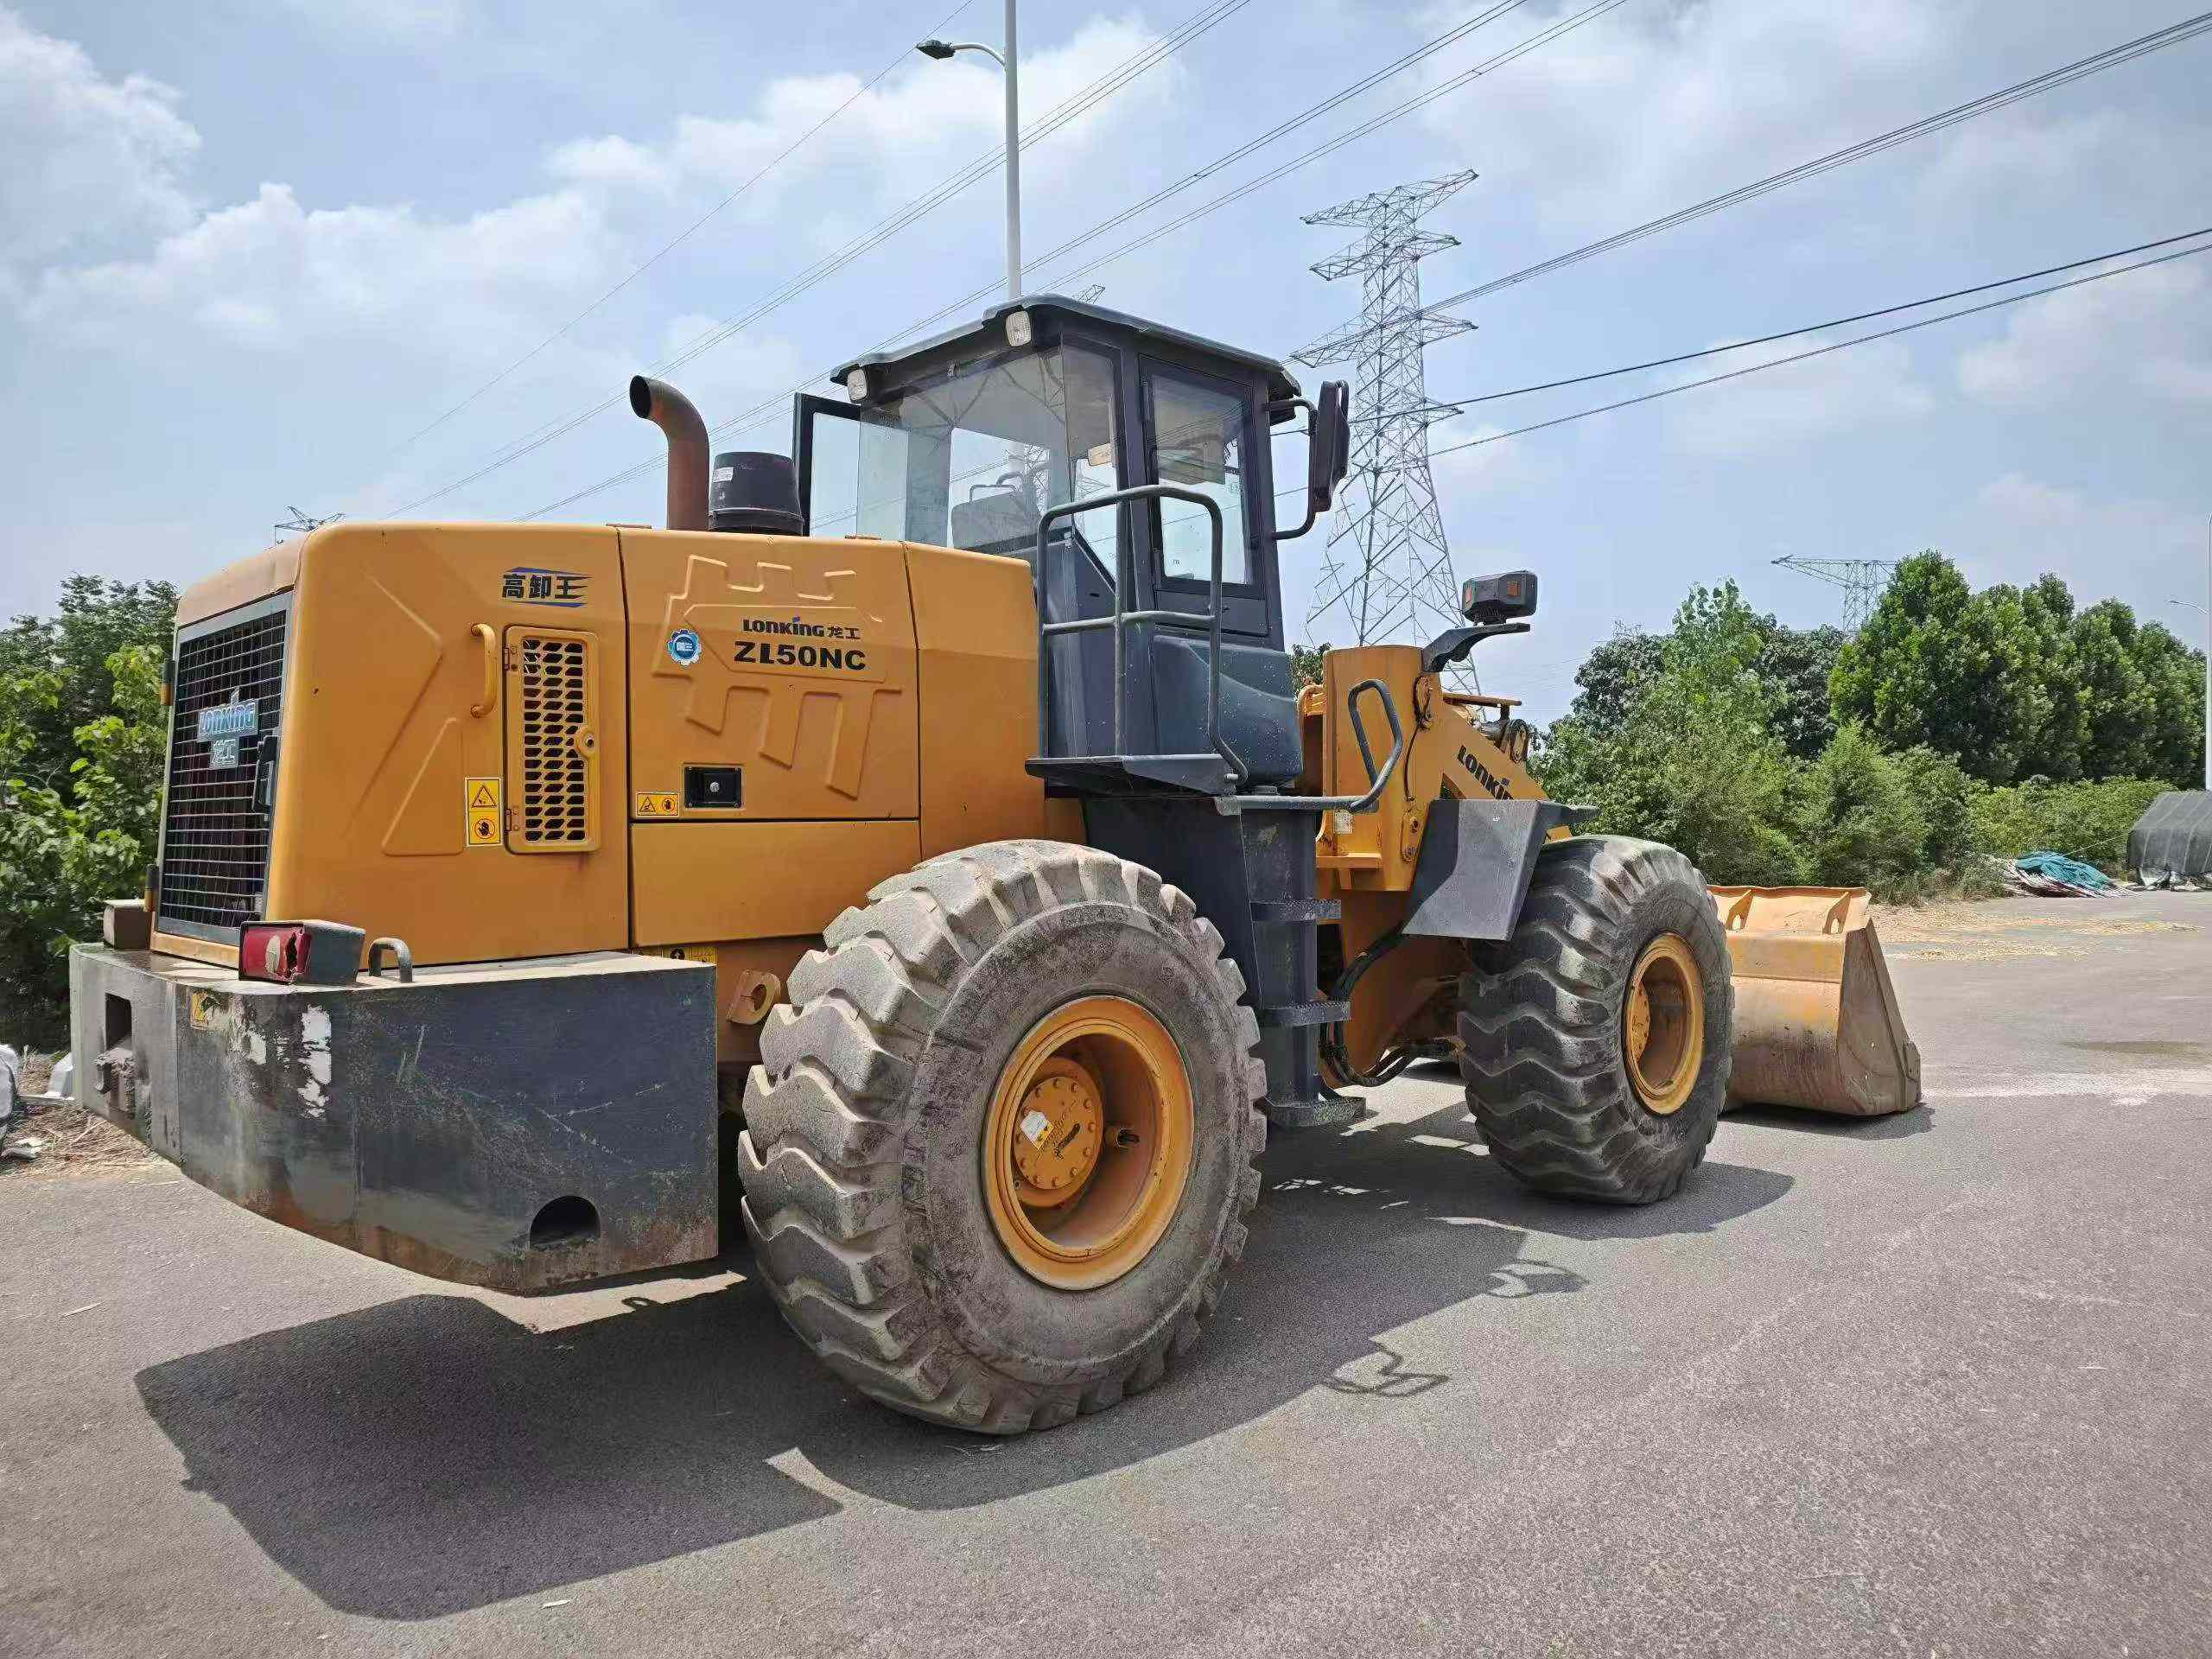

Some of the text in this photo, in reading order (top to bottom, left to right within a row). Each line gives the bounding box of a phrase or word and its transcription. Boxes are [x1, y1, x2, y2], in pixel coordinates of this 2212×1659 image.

[502, 573, 594, 599] 高卸王
[828, 626, 861, 640] 龙工
[734, 640, 866, 671] ZL50NC
